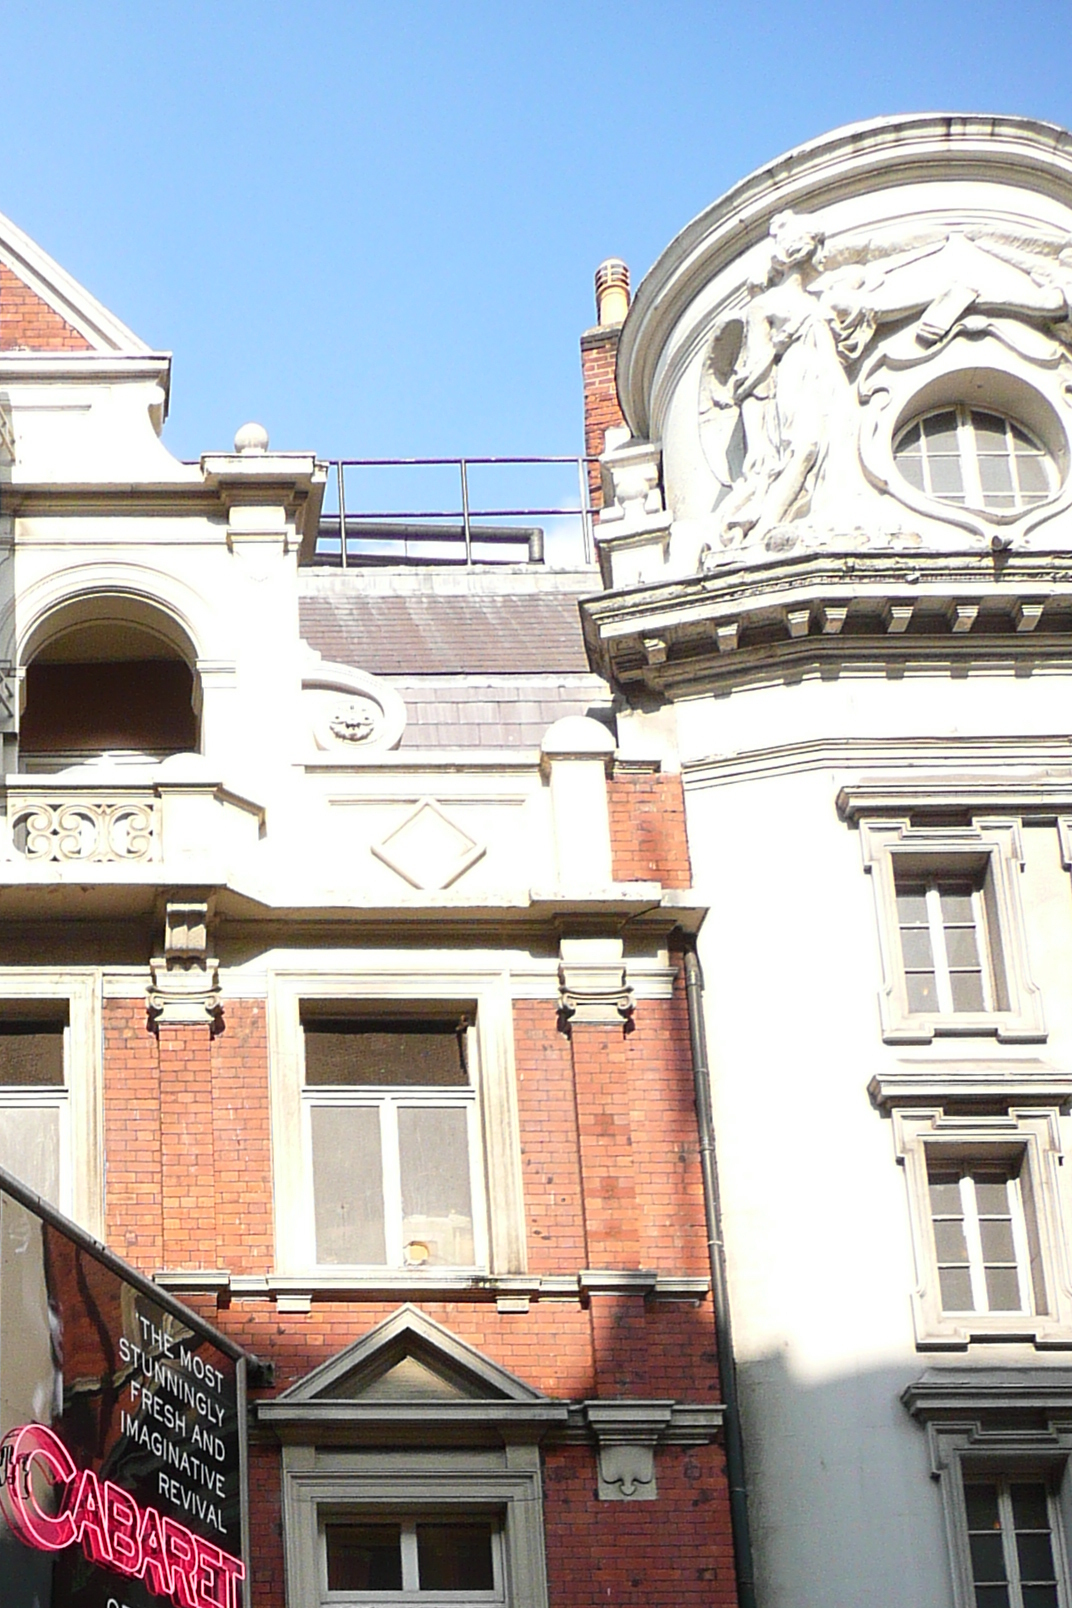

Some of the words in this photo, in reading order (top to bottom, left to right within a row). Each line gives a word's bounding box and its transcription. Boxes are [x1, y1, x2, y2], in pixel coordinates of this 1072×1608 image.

[118, 1337, 225, 1427] STUNNINGLY
[179, 1345, 224, 1393] MOST
[120, 1410, 226, 1498] IMAGINATIVE
[130, 1379, 186, 1437] FRESH
[191, 1424, 226, 1462] AND
[158, 1471, 228, 1534] REVIVAL
